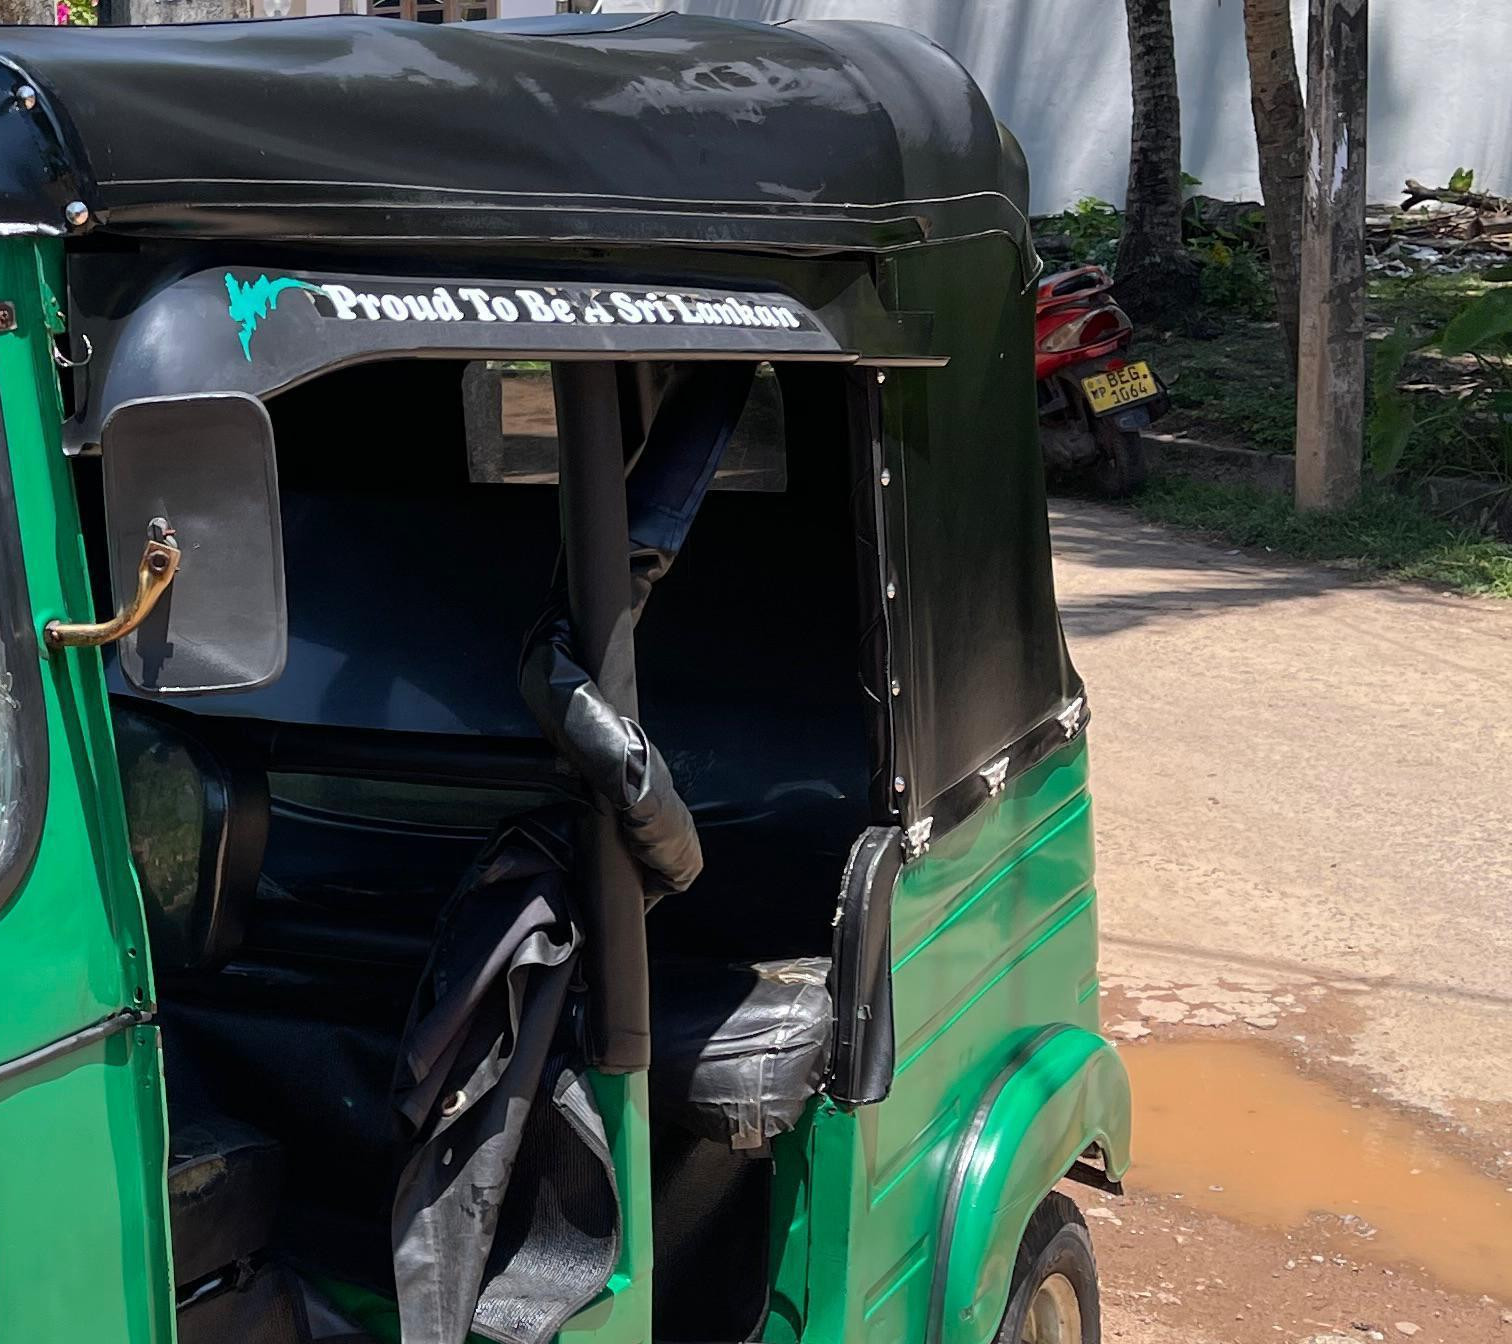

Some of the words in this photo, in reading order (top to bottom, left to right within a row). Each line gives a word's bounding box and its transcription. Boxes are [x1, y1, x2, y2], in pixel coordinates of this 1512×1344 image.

[321, 284, 464, 321] Proud
[459, 288, 519, 322] To
[515, 289, 575, 323] Be
[585, 292, 615, 323] A
[609, 292, 674, 323] Sri
[666, 294, 800, 328] Lankan
